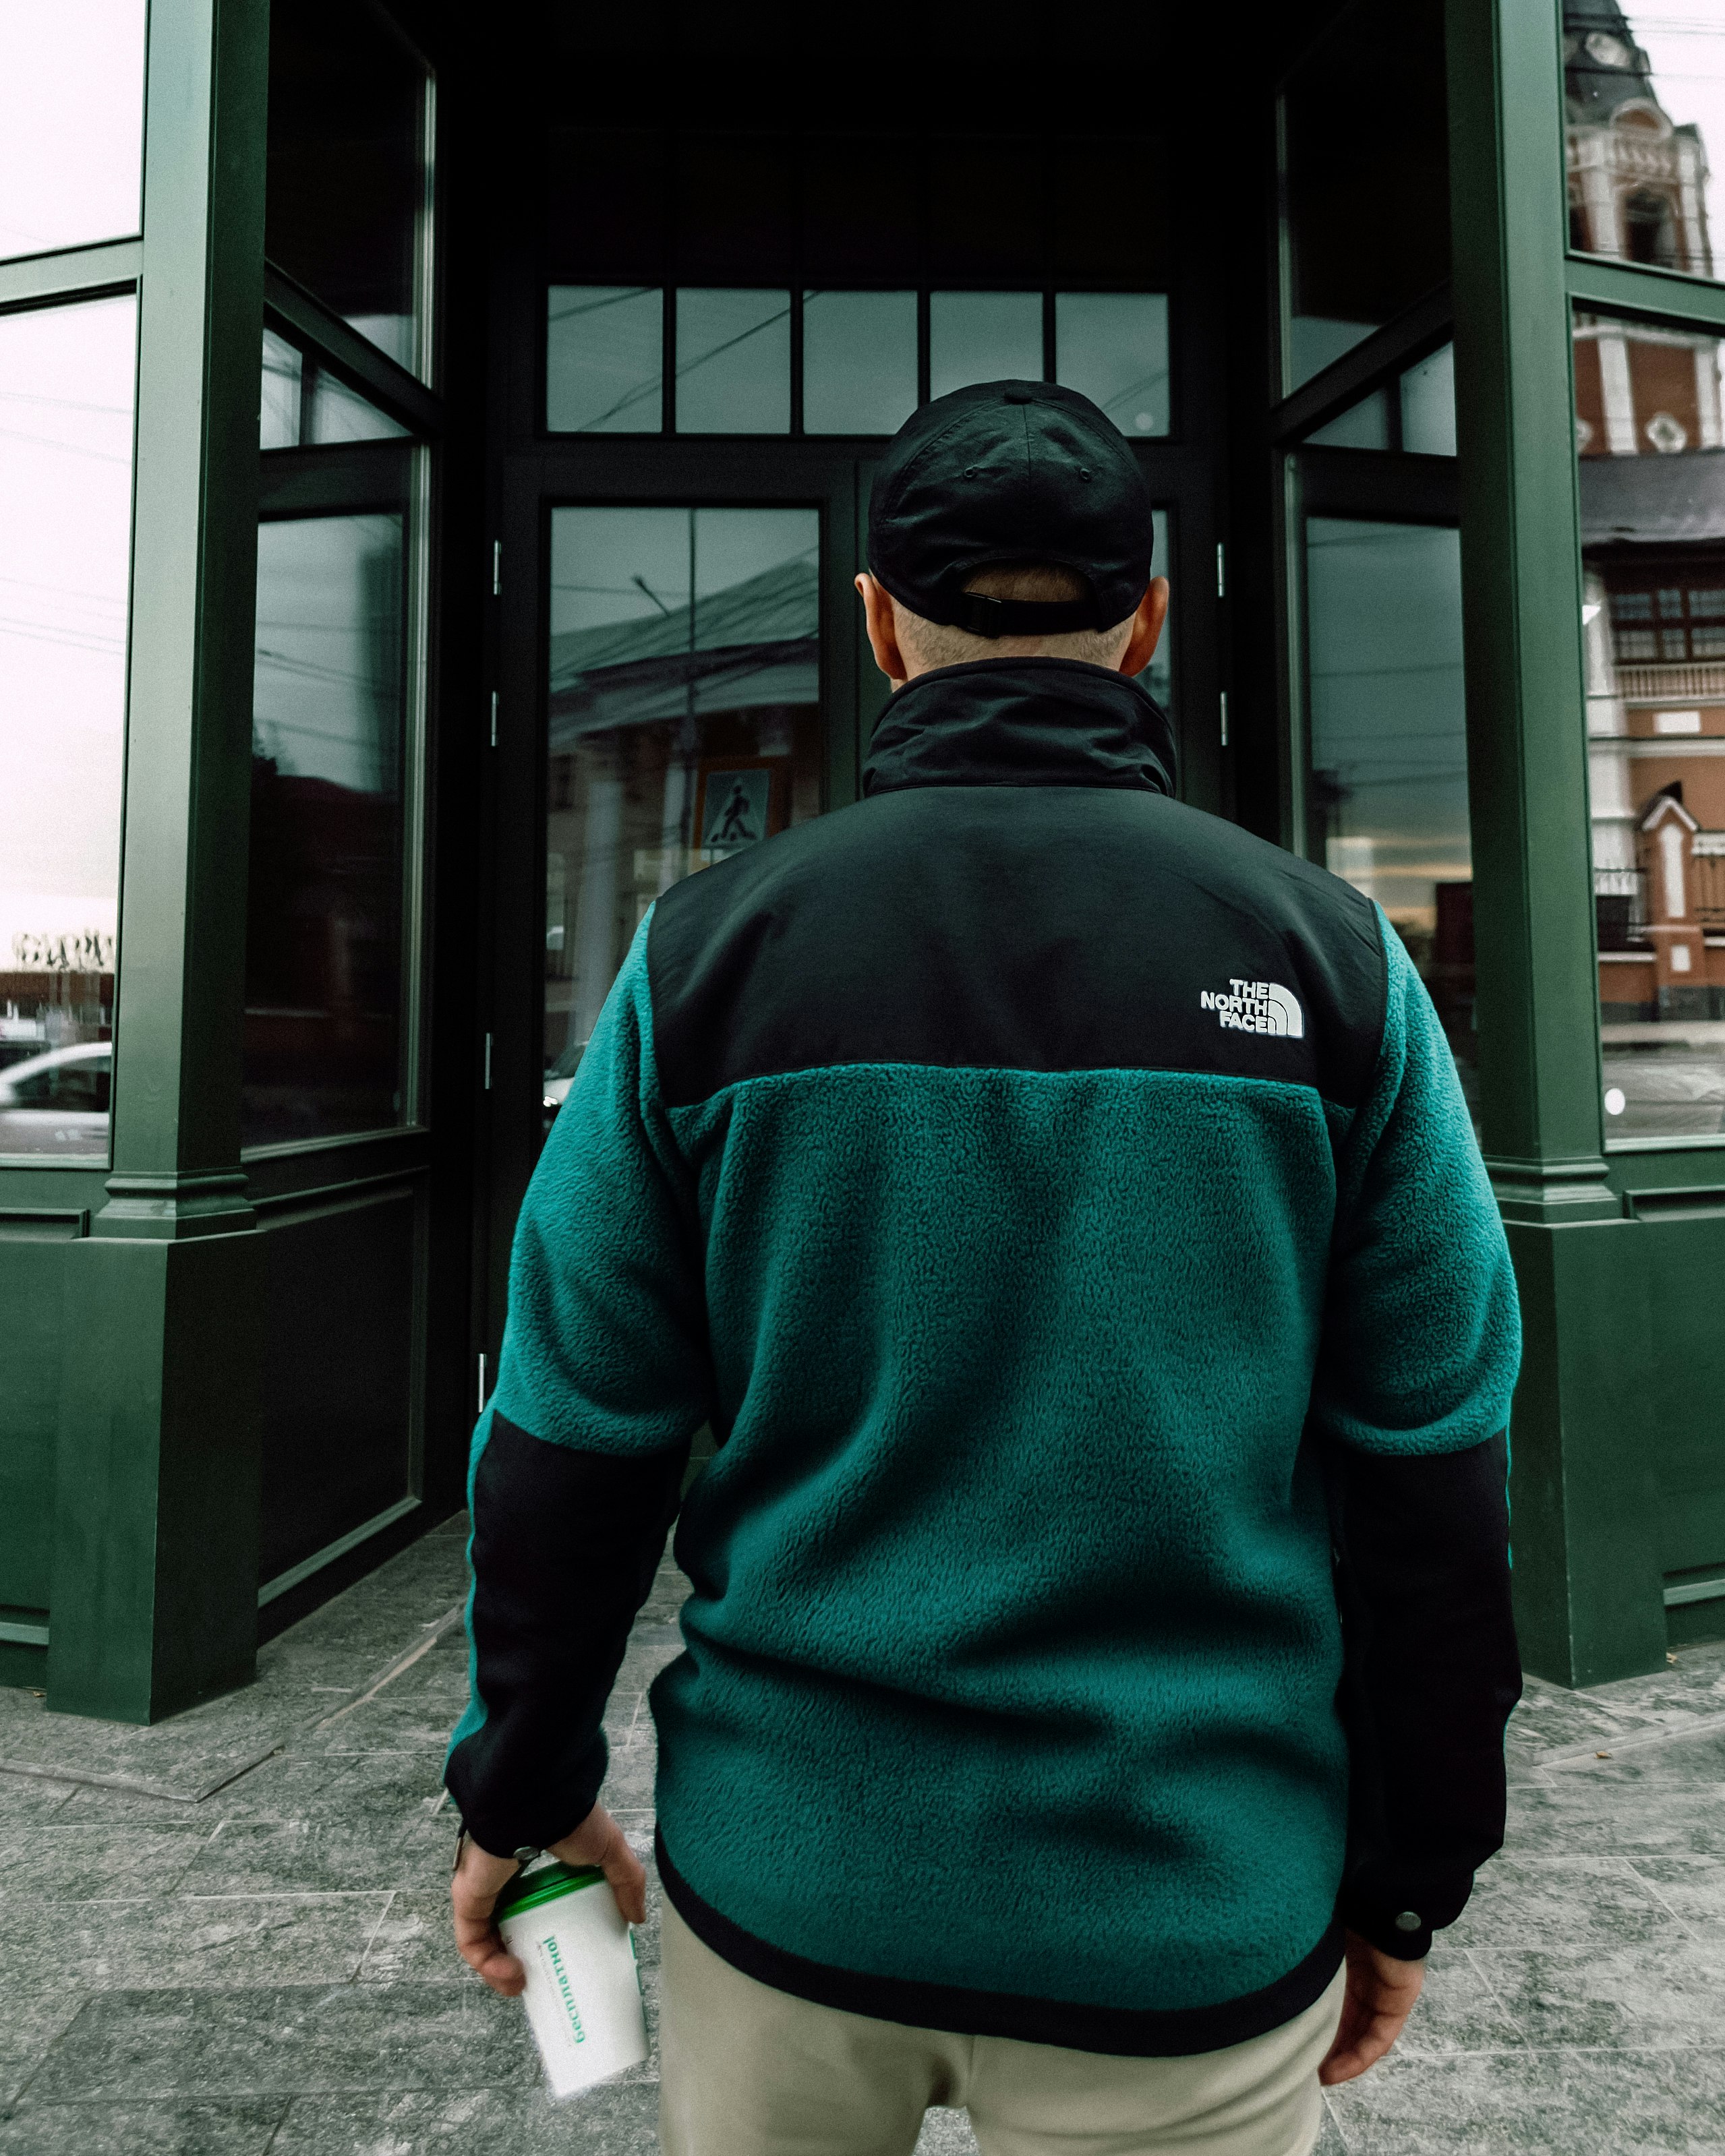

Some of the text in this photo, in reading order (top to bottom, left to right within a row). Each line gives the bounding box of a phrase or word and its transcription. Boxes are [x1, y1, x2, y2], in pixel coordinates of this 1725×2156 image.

[1229, 978, 1269, 999] THE
[1200, 990, 1268, 1016] NORTH
[1219, 1011, 1268, 1033] FACE
